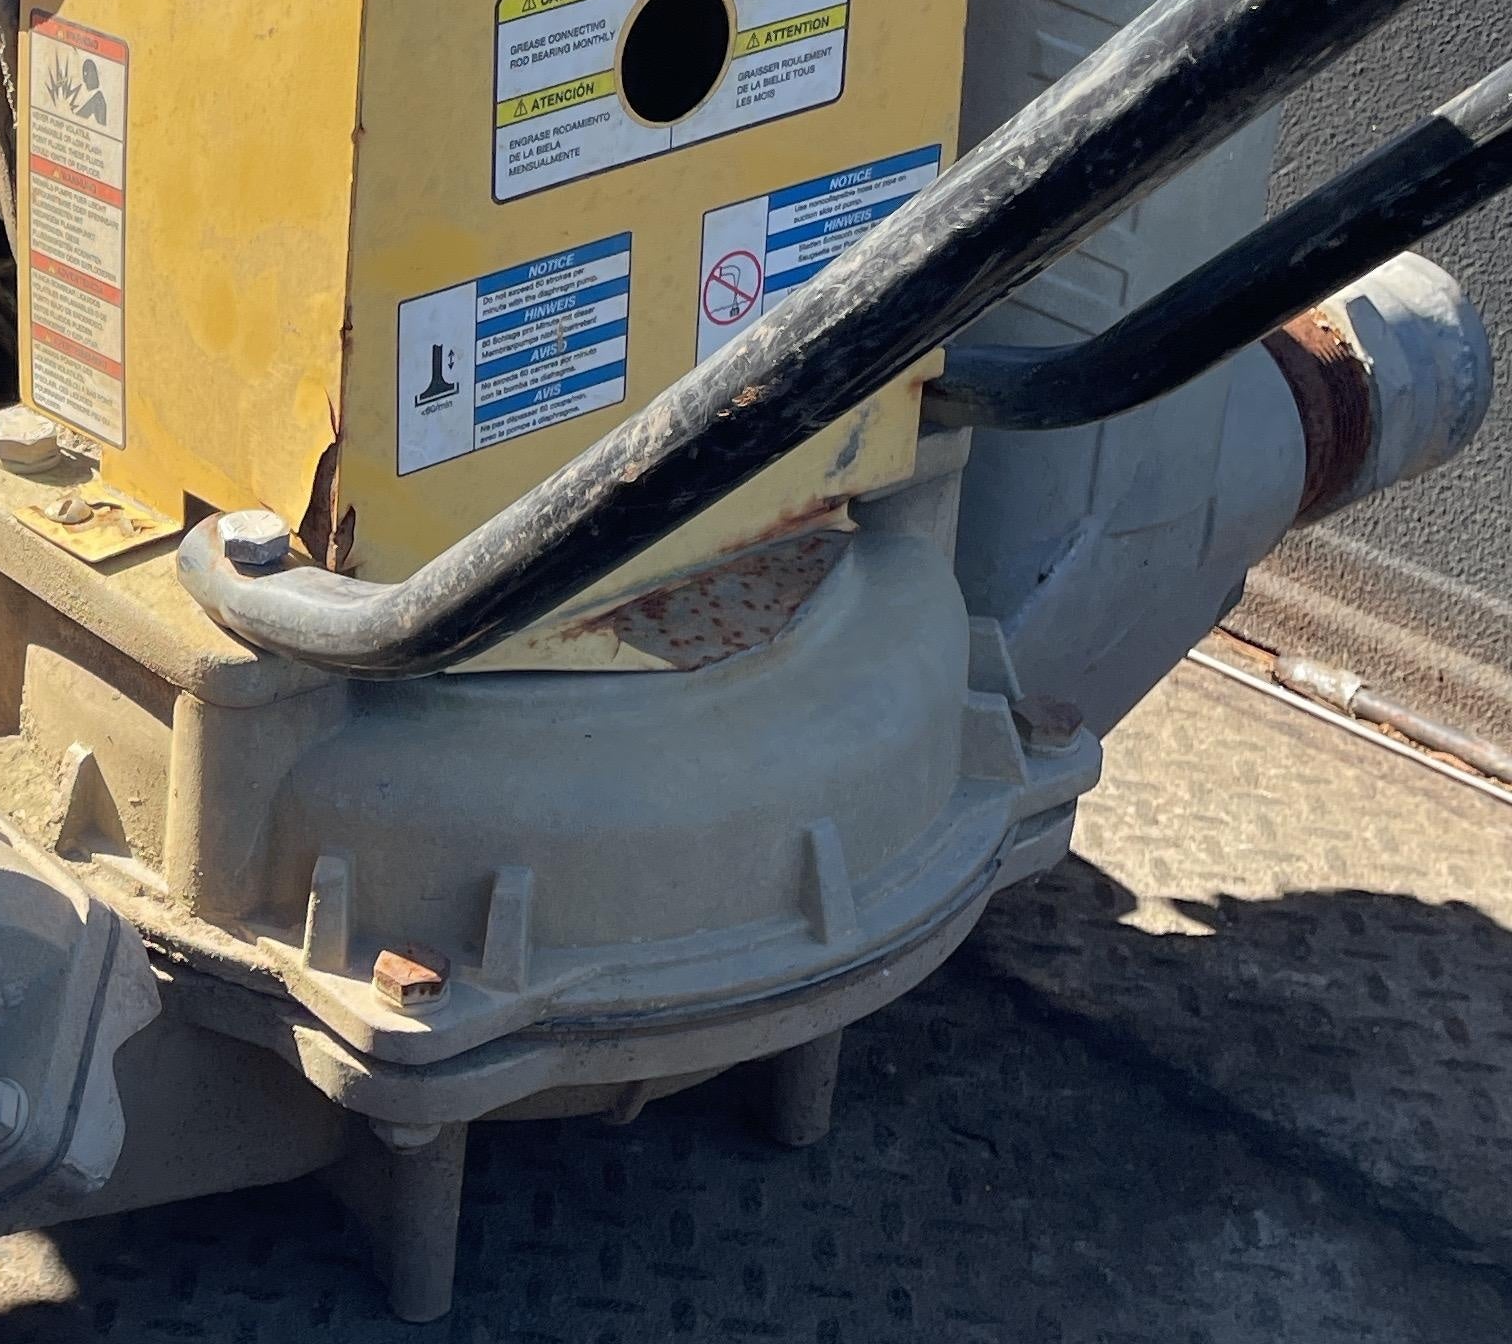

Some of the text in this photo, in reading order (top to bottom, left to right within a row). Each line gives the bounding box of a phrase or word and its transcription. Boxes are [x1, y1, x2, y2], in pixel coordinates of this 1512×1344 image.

[763, 14, 829, 45] ATTENTION
[829, 167, 872, 191] NOTICE
[823, 207, 872, 233] HINWEIS
[528, 252, 575, 278] NOTICE
[524, 294, 576, 322] HINWEIS
[532, 382, 561, 402] AVIS
